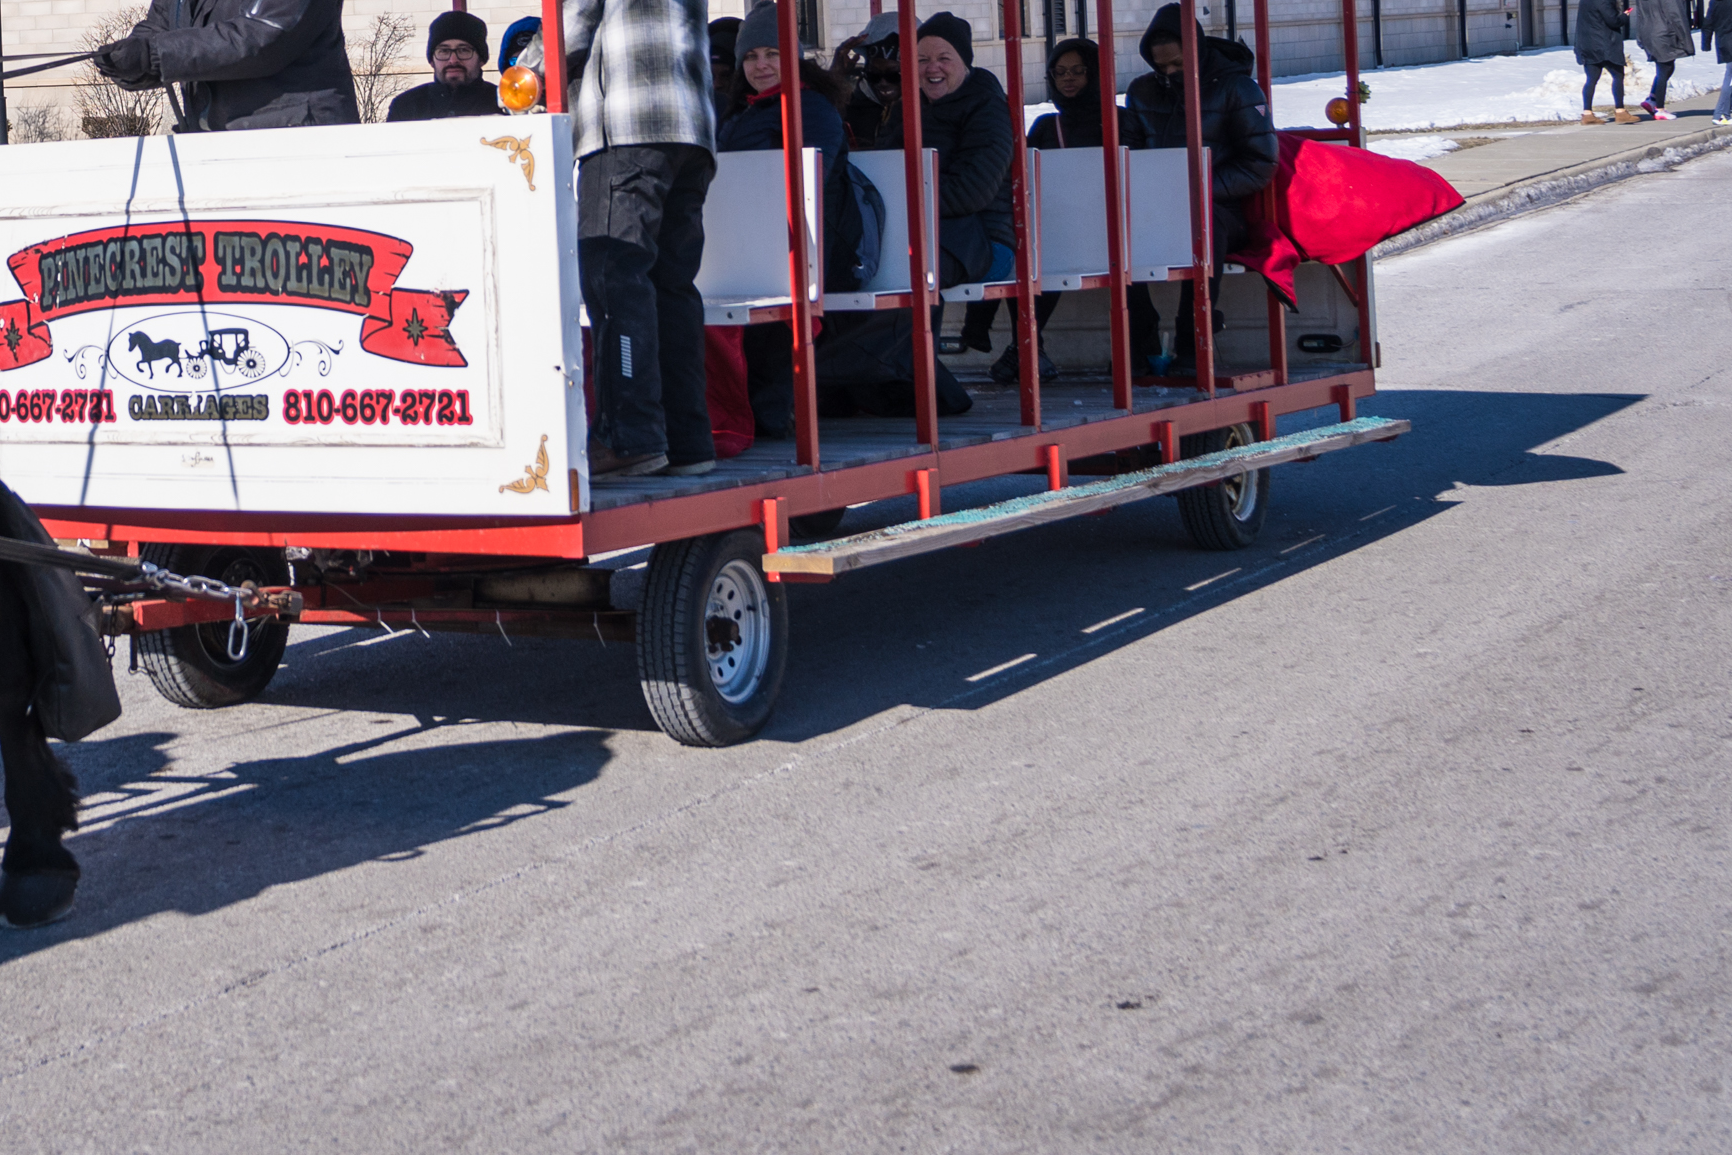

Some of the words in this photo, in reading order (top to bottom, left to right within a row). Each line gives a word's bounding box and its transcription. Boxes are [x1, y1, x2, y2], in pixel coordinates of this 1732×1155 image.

[39, 232, 206, 311] PINECREST
[214, 232, 374, 307] TROLLEY
[282, 389, 473, 425] 810-667-2721
